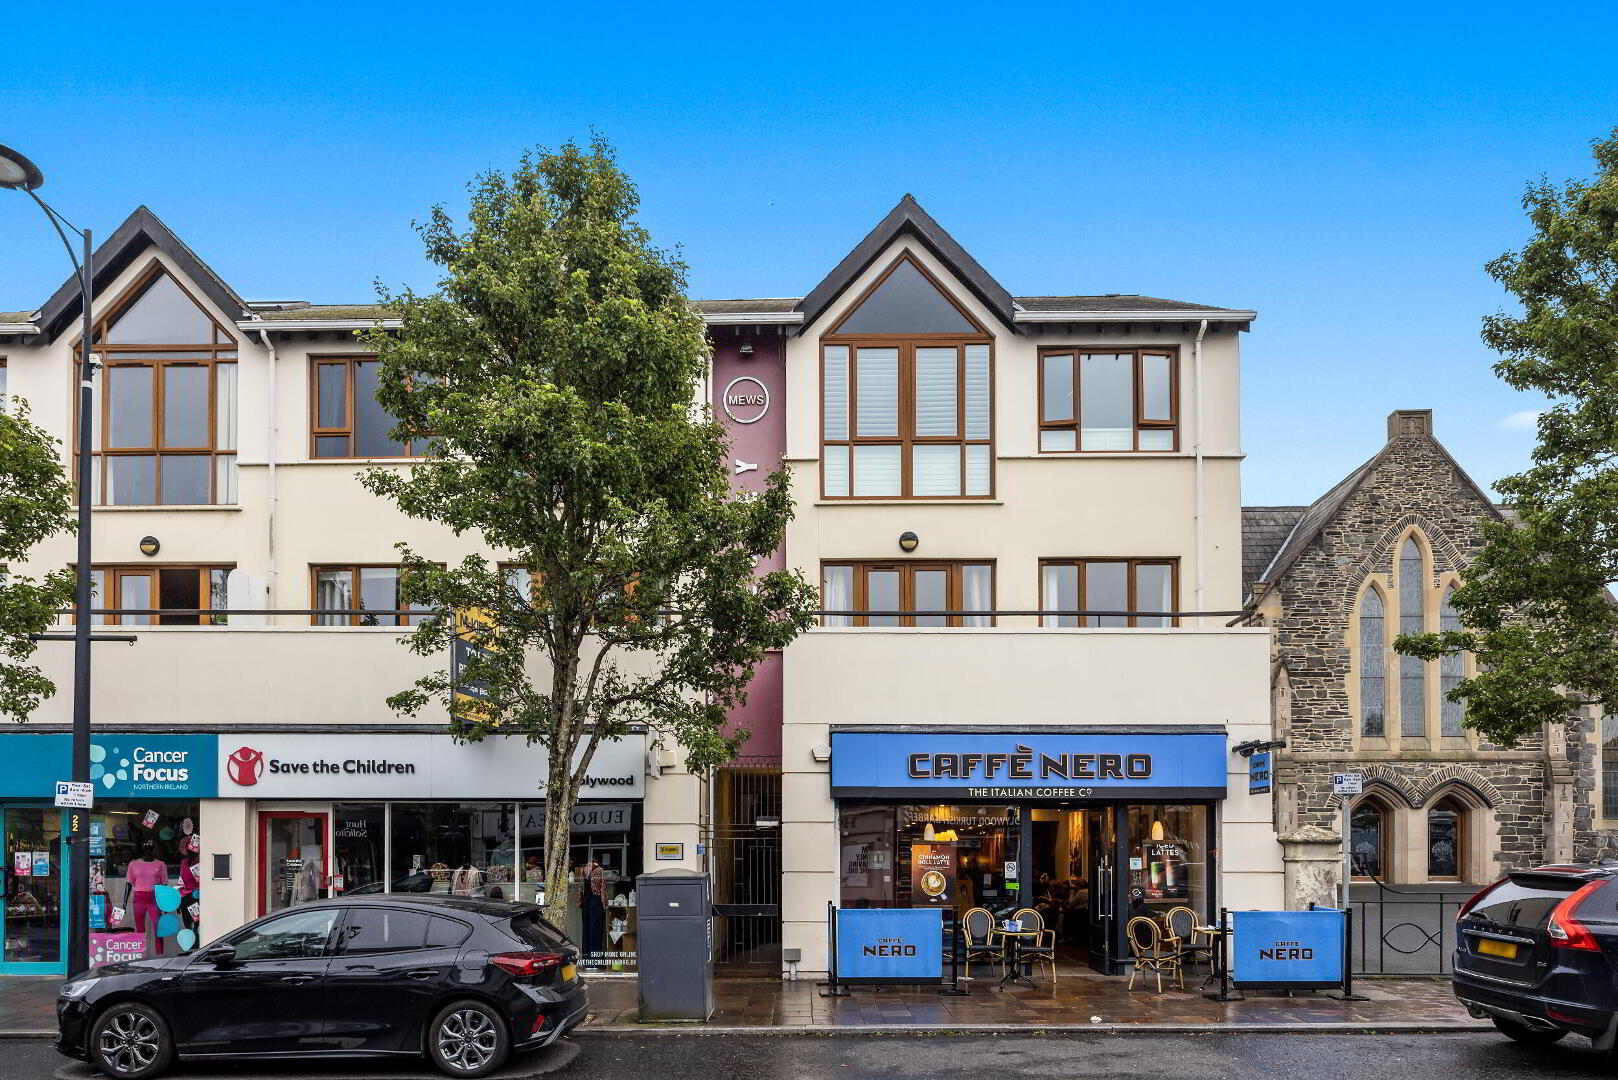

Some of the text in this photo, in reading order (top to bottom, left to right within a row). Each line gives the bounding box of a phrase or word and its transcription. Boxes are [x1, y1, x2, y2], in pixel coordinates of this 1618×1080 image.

[728, 395, 764, 405] MEWS
[133, 747, 188, 763] Cancer
[908, 743, 1153, 779] CAFFÈ NERO
[133, 764, 189, 781] Focus
[269, 759, 415, 774] Save the Children
[570, 775, 633, 788] olywood
[1250, 771, 1268, 782] NERO
[969, 788, 988, 797] THE
[991, 788, 1033, 797] ITALIAN
[1036, 788, 1075, 797] COFFEE
[106, 939, 142, 950] Cancer
[106, 950, 143, 962] Focus
[863, 945, 916, 957] NERO
[1259, 948, 1313, 960] NERO
